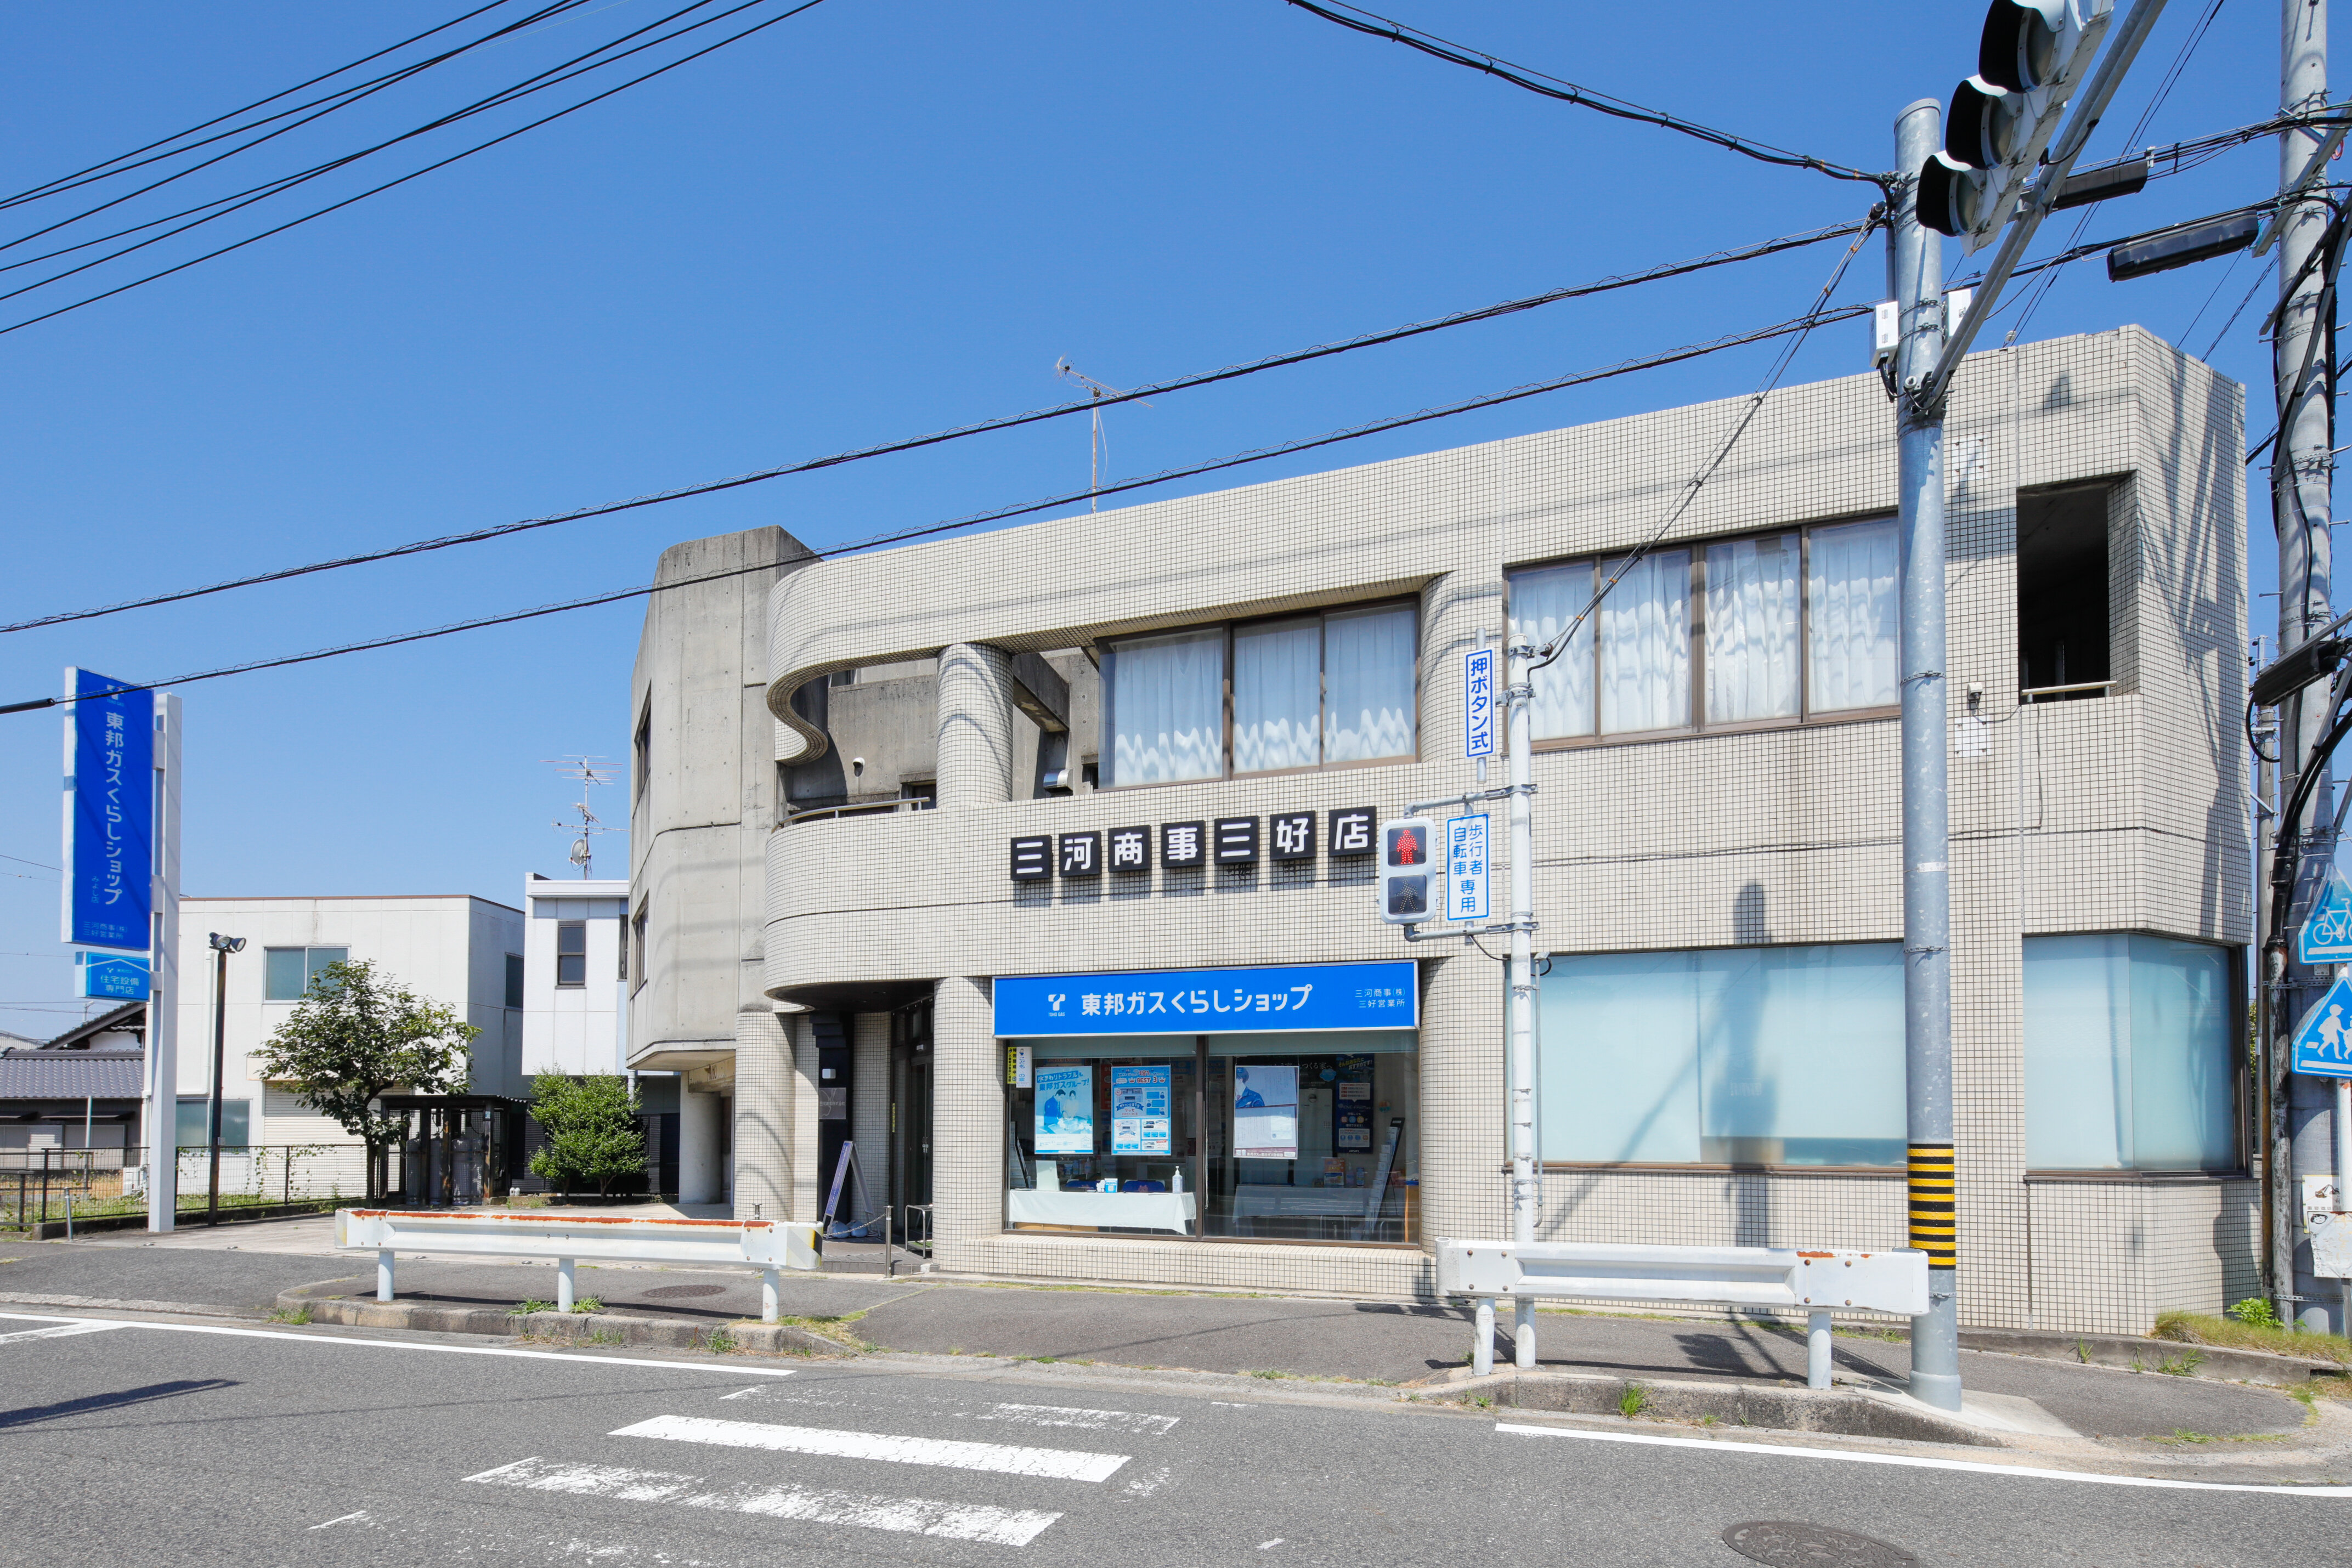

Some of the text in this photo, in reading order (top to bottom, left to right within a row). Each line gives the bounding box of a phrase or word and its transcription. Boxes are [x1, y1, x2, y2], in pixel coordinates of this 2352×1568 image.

[1470, 656, 1489, 750] 押ボタン式
[104, 711, 124, 905] 東邦ガスくらしショップ
[1016, 814, 1369, 875] 三河商事三好店
[1453, 826, 1467, 876] 自転車
[1468, 824, 1483, 875] 歩行者
[1460, 879, 1475, 913] 専用
[100, 974, 139, 986] 住宅設備
[105, 984, 134, 995] 専門店
[1081, 983, 1313, 1016] 東邦ガスくらしショップ
[1359, 999, 1405, 1008] 三好営業所
[1037, 1071, 1083, 1082] 水まわりトラブルも
